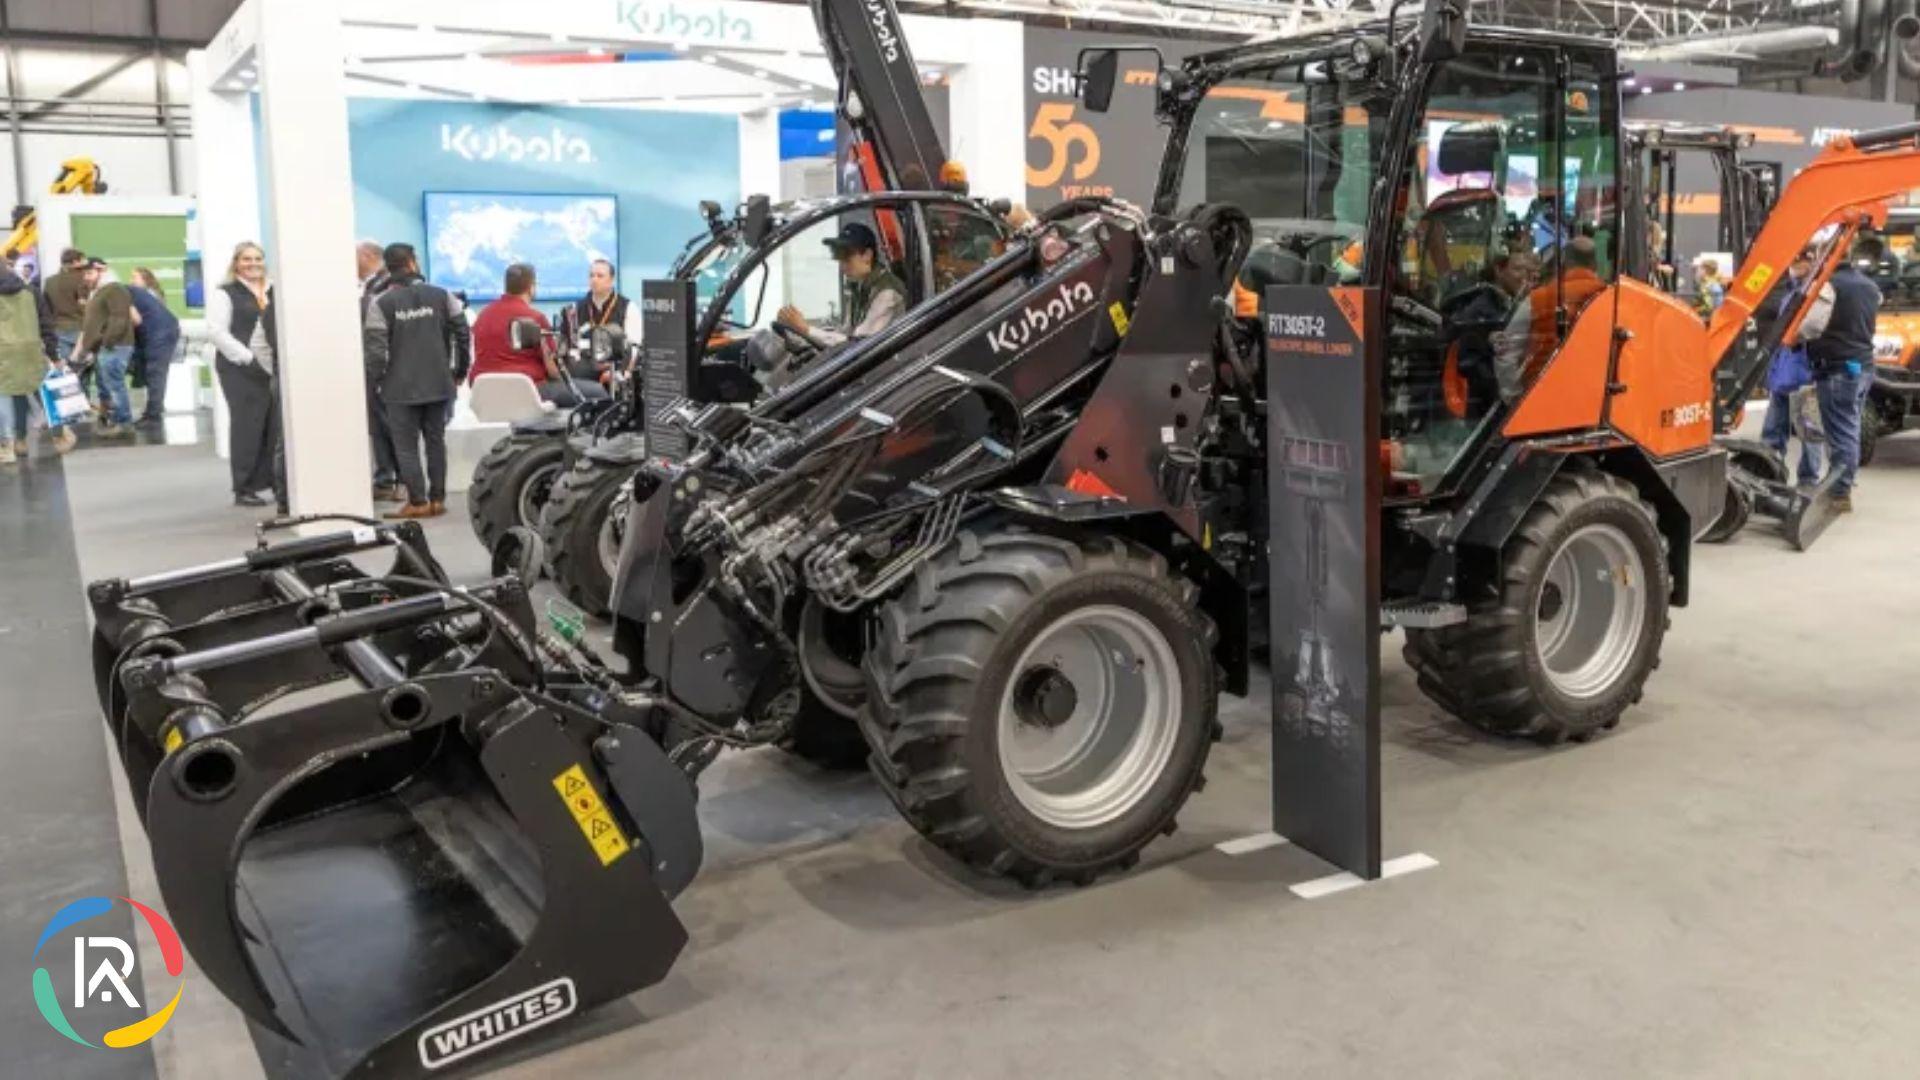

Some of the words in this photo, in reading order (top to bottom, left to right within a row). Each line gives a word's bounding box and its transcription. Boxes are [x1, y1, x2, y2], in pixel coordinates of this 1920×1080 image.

[616, 0, 753, 41] Kubota
[440, 122, 592, 164] Kubota
[1026, 102, 1101, 188] 50
[986, 281, 1094, 353] Kubota
[1268, 312, 1326, 338] RT305T-2
[433, 987, 565, 1057] WHITES
